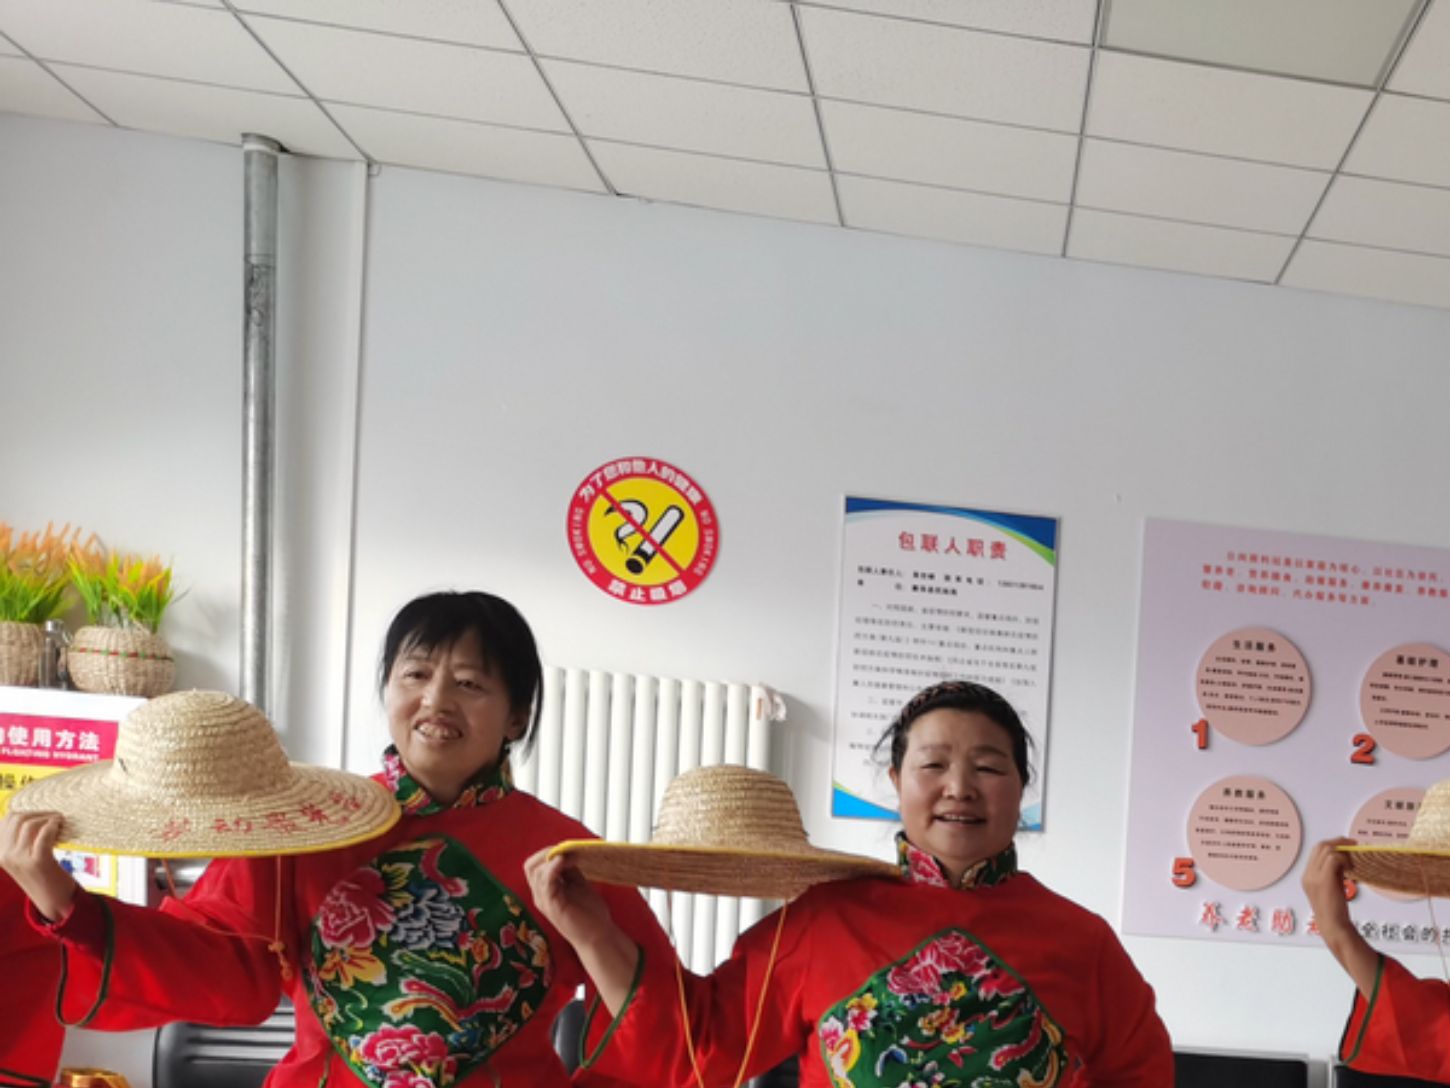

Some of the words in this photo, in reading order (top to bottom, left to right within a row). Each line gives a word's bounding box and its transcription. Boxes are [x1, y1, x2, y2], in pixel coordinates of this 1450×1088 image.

[898, 530, 1007, 561] 包联人职责
[608, 578, 688, 602] 禁止吸烟
[0, 726, 100, 751] 使用方法
[1192, 719, 1210, 750] 1
[1350, 733, 1378, 765] 2
[1172, 857, 1198, 889] 5
